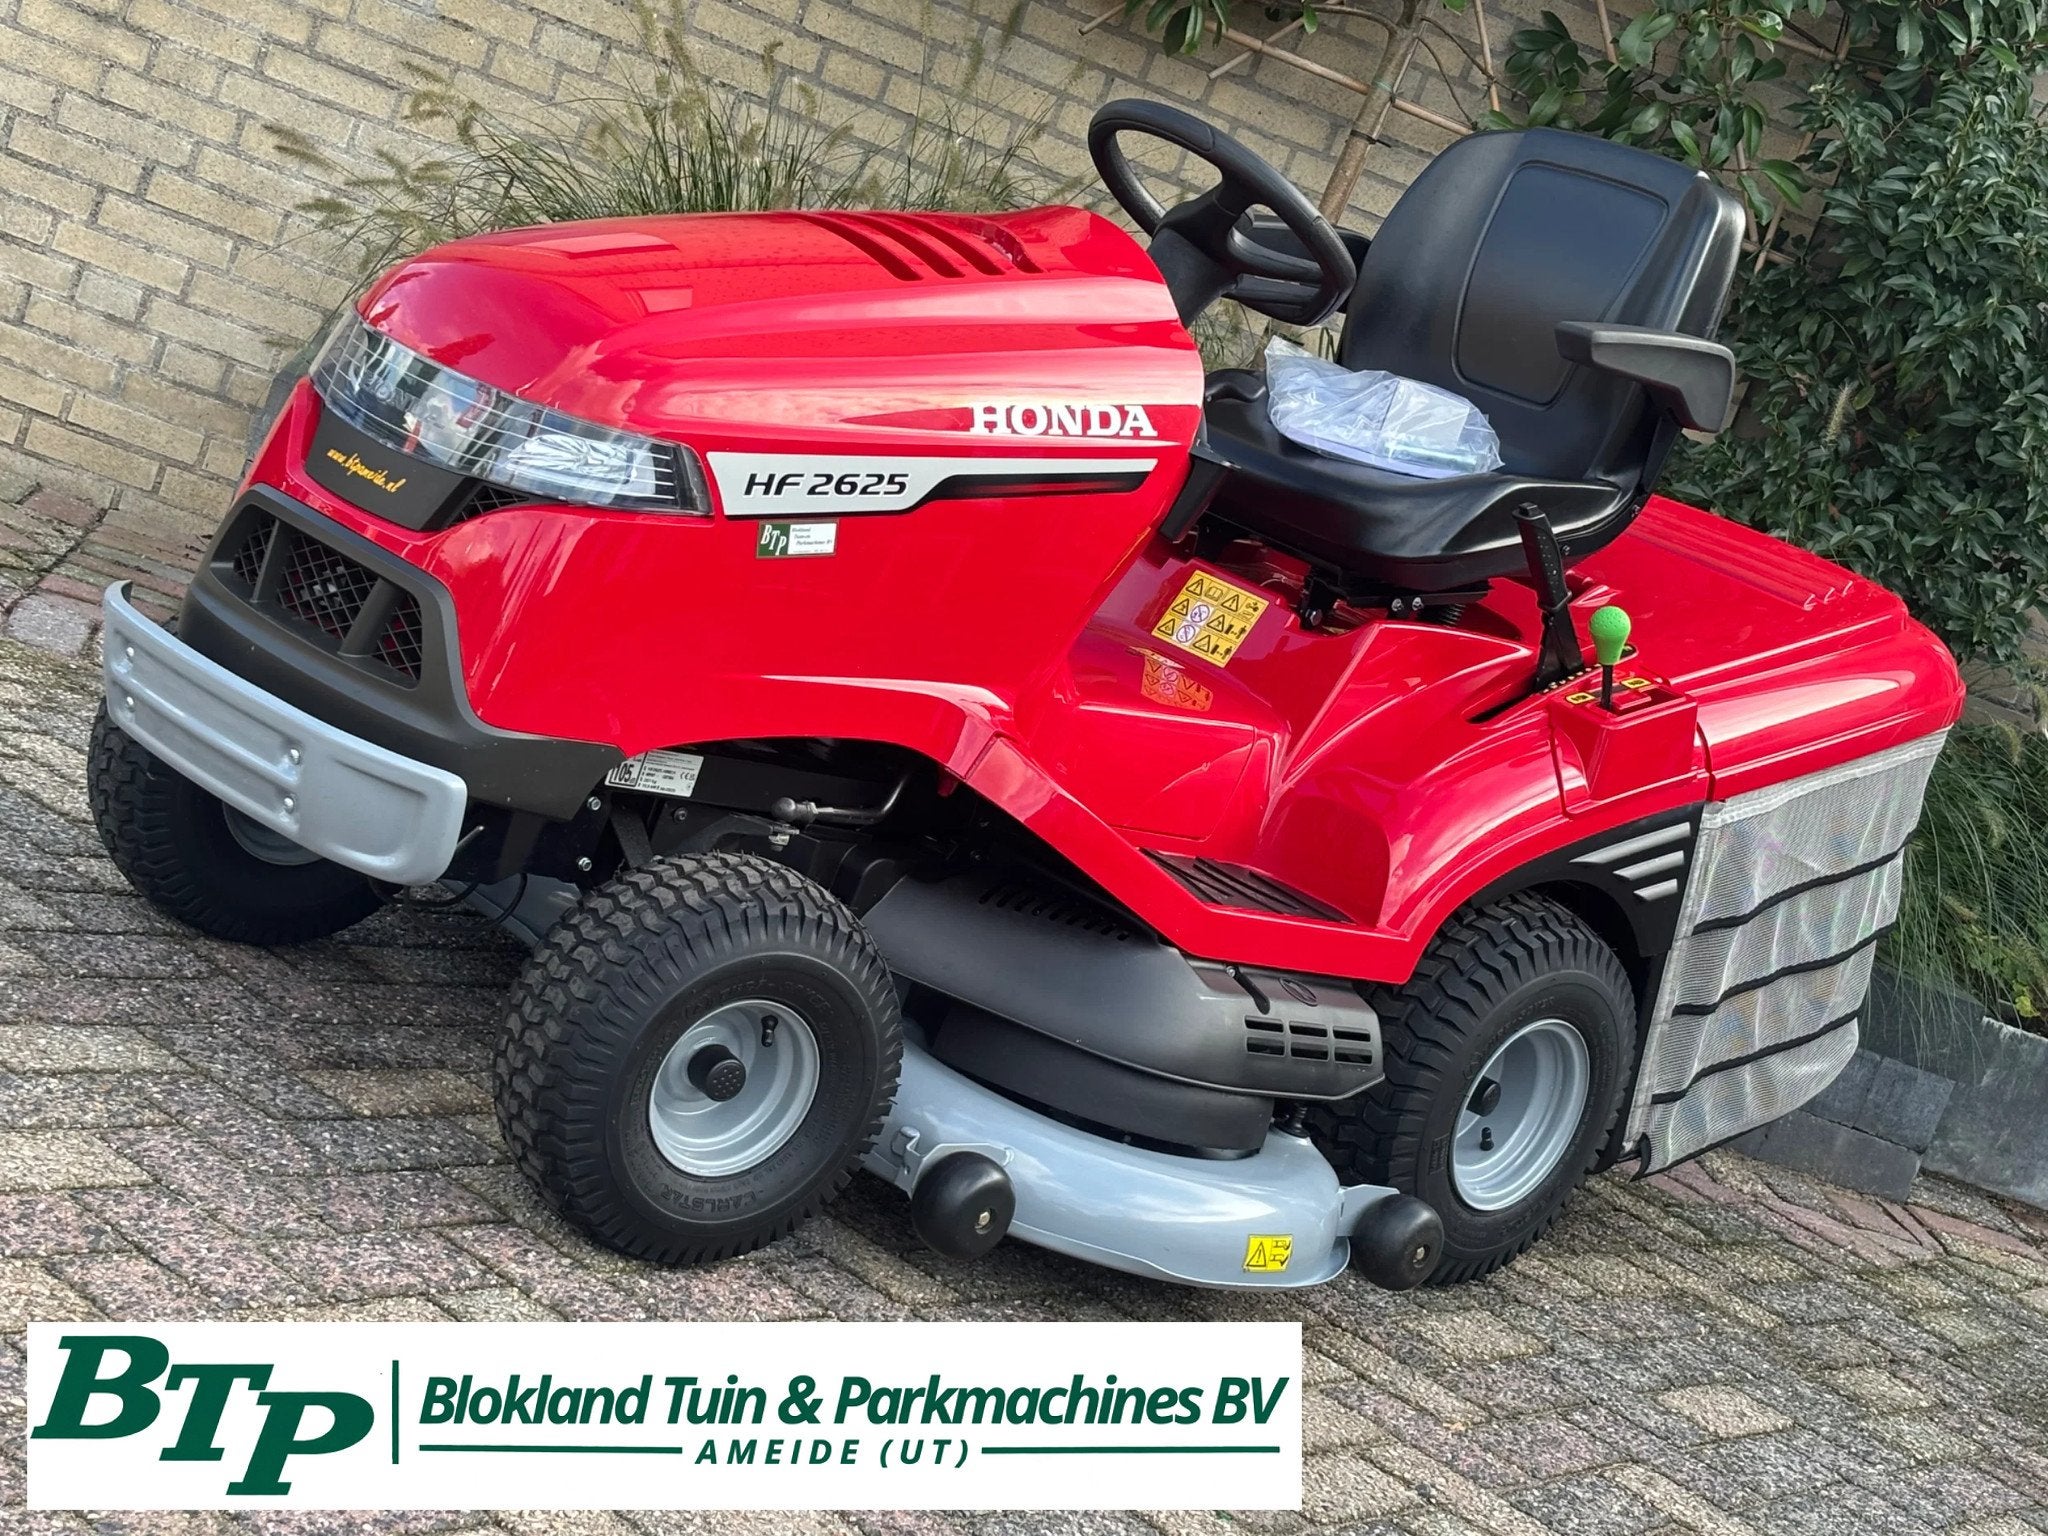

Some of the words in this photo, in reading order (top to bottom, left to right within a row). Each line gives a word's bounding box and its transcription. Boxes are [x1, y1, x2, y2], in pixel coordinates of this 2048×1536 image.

[969, 404, 1158, 437] HONDA
[744, 473, 805, 496] HF
[806, 473, 909, 496] 2625
[760, 524, 787, 556] BTP
[660, 1183, 756, 1212] CARLSTAR
